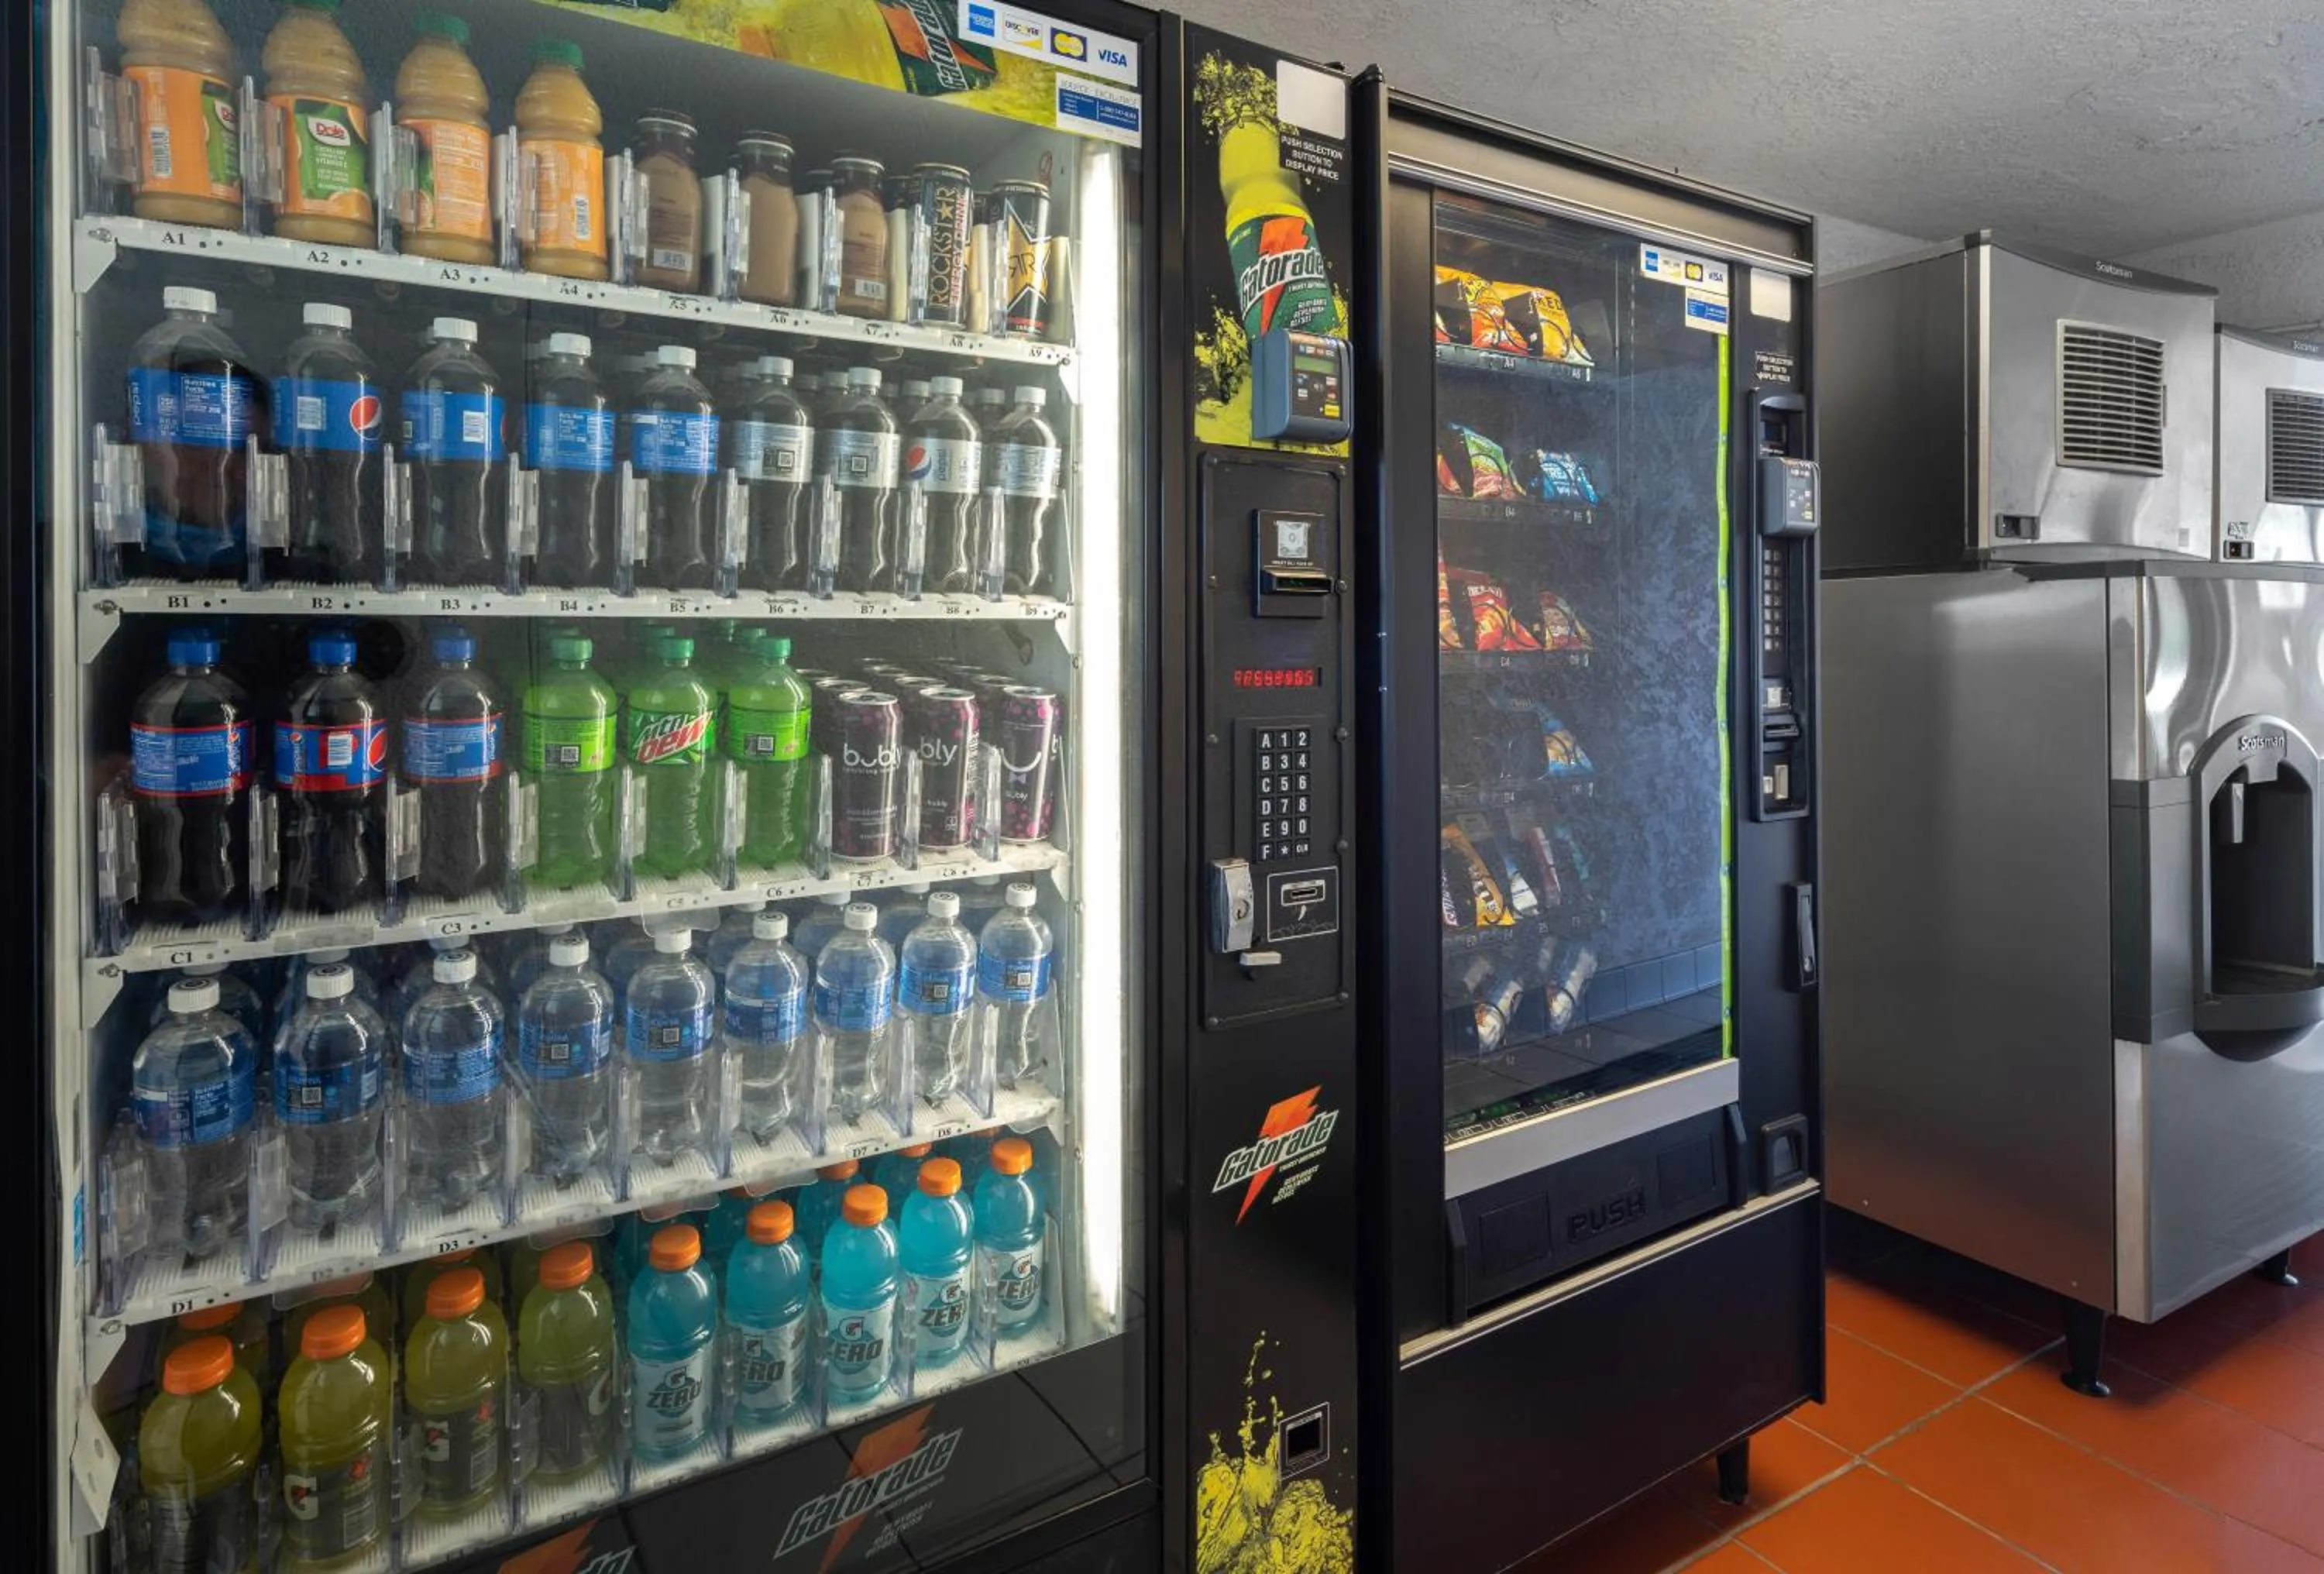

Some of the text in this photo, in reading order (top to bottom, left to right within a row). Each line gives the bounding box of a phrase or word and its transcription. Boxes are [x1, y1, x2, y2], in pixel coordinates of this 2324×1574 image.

[1006, 21, 1040, 36] DISCOVER
[1098, 49, 1128, 67] VISA
[315, 121, 346, 140] Dole
[1281, 136, 1343, 161] PUSH SELECTION
[1291, 149, 1323, 166] BUTTON
[1285, 160, 1339, 181] DISPLAY PRICE
[162, 231, 186, 246] A1
[308, 249, 329, 263] A2
[440, 268, 461, 281] A3
[559, 282, 578, 295] A4
[937, 448, 947, 482] pepsi
[168, 596, 189, 608] B1
[311, 597, 333, 610] B2
[441, 599, 461, 610] B3
[561, 600, 578, 611] B4
[670, 602, 686, 613] B5
[769, 603, 784, 613] B6
[861, 605, 875, 614] B7
[1262, 731, 1307, 748] A 1 2
[2240, 735, 2284, 751] Scotsman
[843, 742, 902, 769] bubly
[920, 736, 958, 767] bly
[1262, 754, 1306, 771] B 3 4
[1262, 775, 1307, 792] C 5 6
[1262, 797, 1307, 815] D 7 8
[1263, 819, 1307, 837] E 9 0
[1263, 844, 1271, 860] F
[766, 887, 782, 898] C6
[441, 923, 462, 935] C3
[170, 951, 192, 964] C1
[1212, 1111, 1339, 1194] Gatorade
[1568, 1187, 1648, 1241] PUSH
[438, 1240, 459, 1253] D3
[171, 1299, 193, 1315] D1
[742, 1359, 786, 1383] ERO
[773, 1428, 964, 1561] Gatorade
